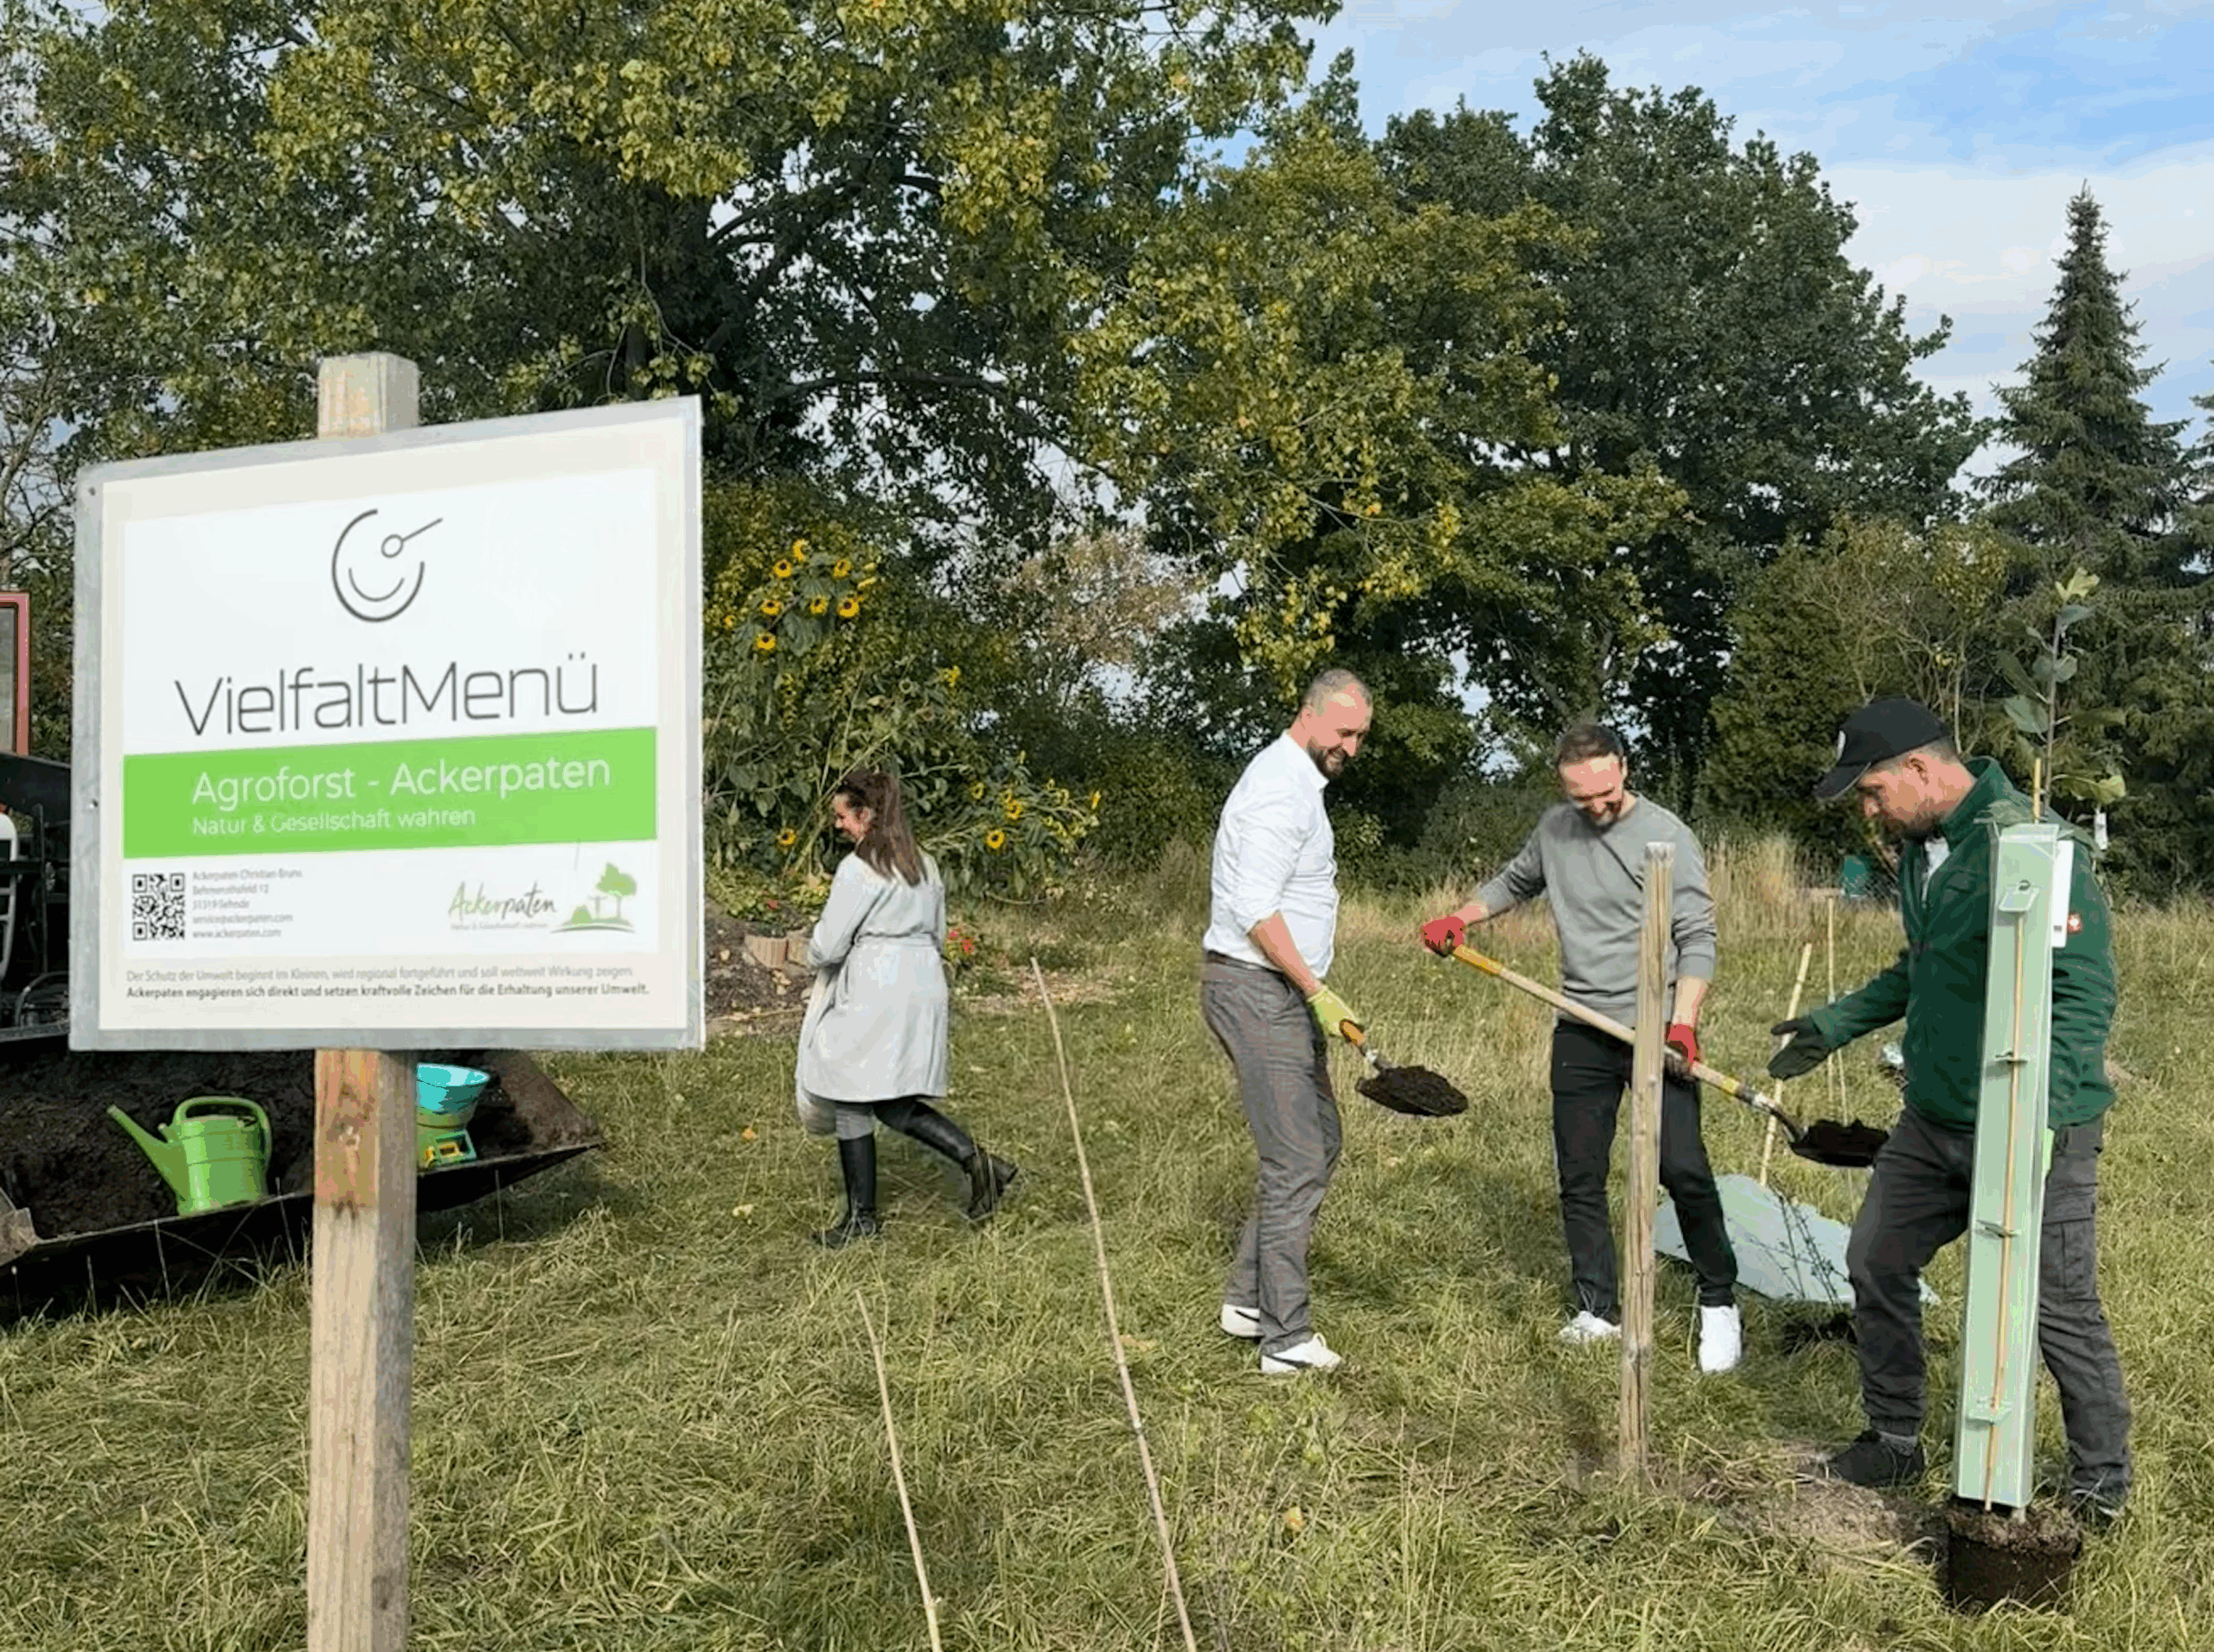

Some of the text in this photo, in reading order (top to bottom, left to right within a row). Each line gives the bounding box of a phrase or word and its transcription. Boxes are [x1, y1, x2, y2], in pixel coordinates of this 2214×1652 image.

[175, 651, 598, 736] VielfaltMenü
[192, 766, 355, 812] Agroforst
[390, 758, 611, 799] Ackerpaten
[192, 807, 477, 835] Natur & Gesellschaft wahren
[448, 880, 557, 921] Ackerpaten
[126, 970, 144, 982] Der
[145, 970, 177, 982] Schutz
[178, 970, 195, 981] der
[195, 969, 234, 981] Umwelt
[275, 968, 289, 980] im
[332, 967, 355, 979] wird
[355, 966, 398, 982] regional
[458, 965, 478, 978] und
[480, 965, 498, 978] soll
[547, 964, 593, 980] Wirkung
[126, 981, 651, 1001] Ackerpaten engagieren sich direkt und setzen kraftvolle Zeichen für die Erhaltung unserer Umwelt.
